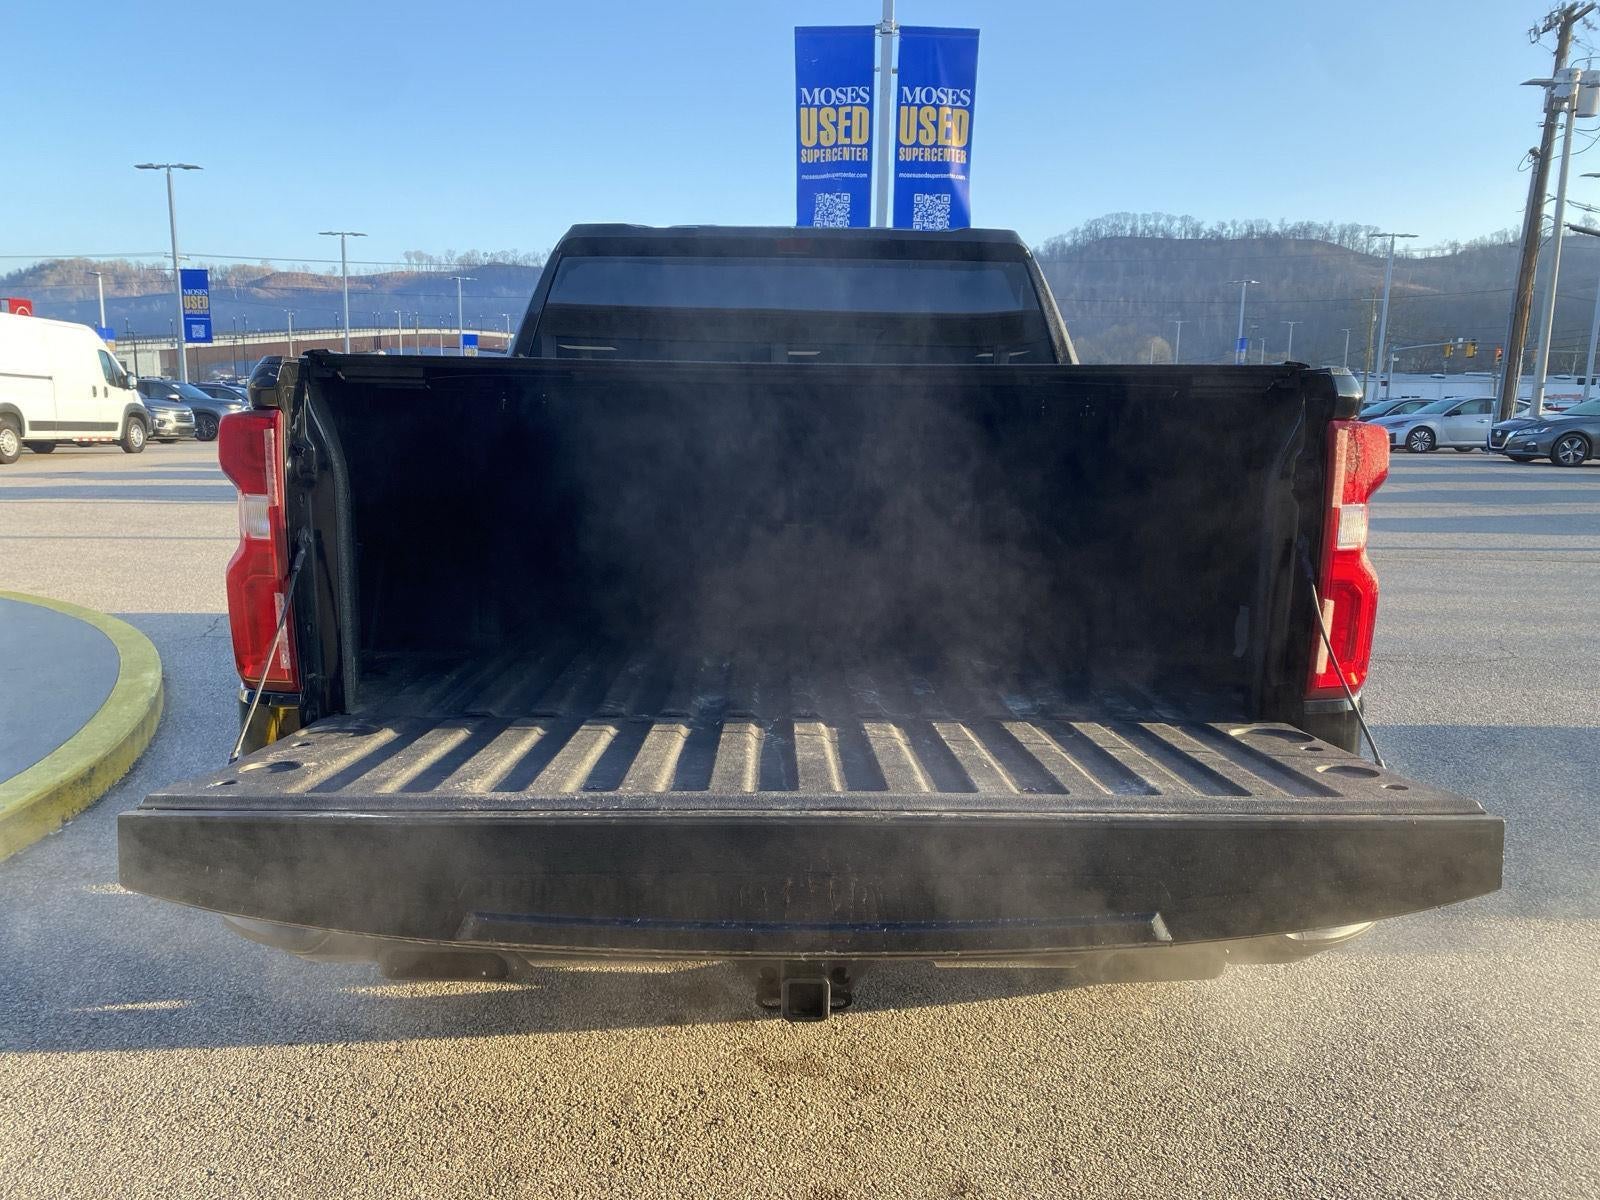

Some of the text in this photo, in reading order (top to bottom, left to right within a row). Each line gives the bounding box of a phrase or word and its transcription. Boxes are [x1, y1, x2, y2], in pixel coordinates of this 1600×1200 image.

[800, 86, 869, 105] MOSES
[901, 86, 971, 106] MOSES
[800, 106, 869, 147] USED
[899, 106, 969, 147] USED
[801, 147, 868, 163] SUPERCENTER
[899, 147, 967, 163] SUPERCENTER
[801, 172, 868, 180] mosesusedsupercenter.com
[899, 172, 966, 180] mosesusedsupercenter.com
[183, 296, 209, 309] USED
